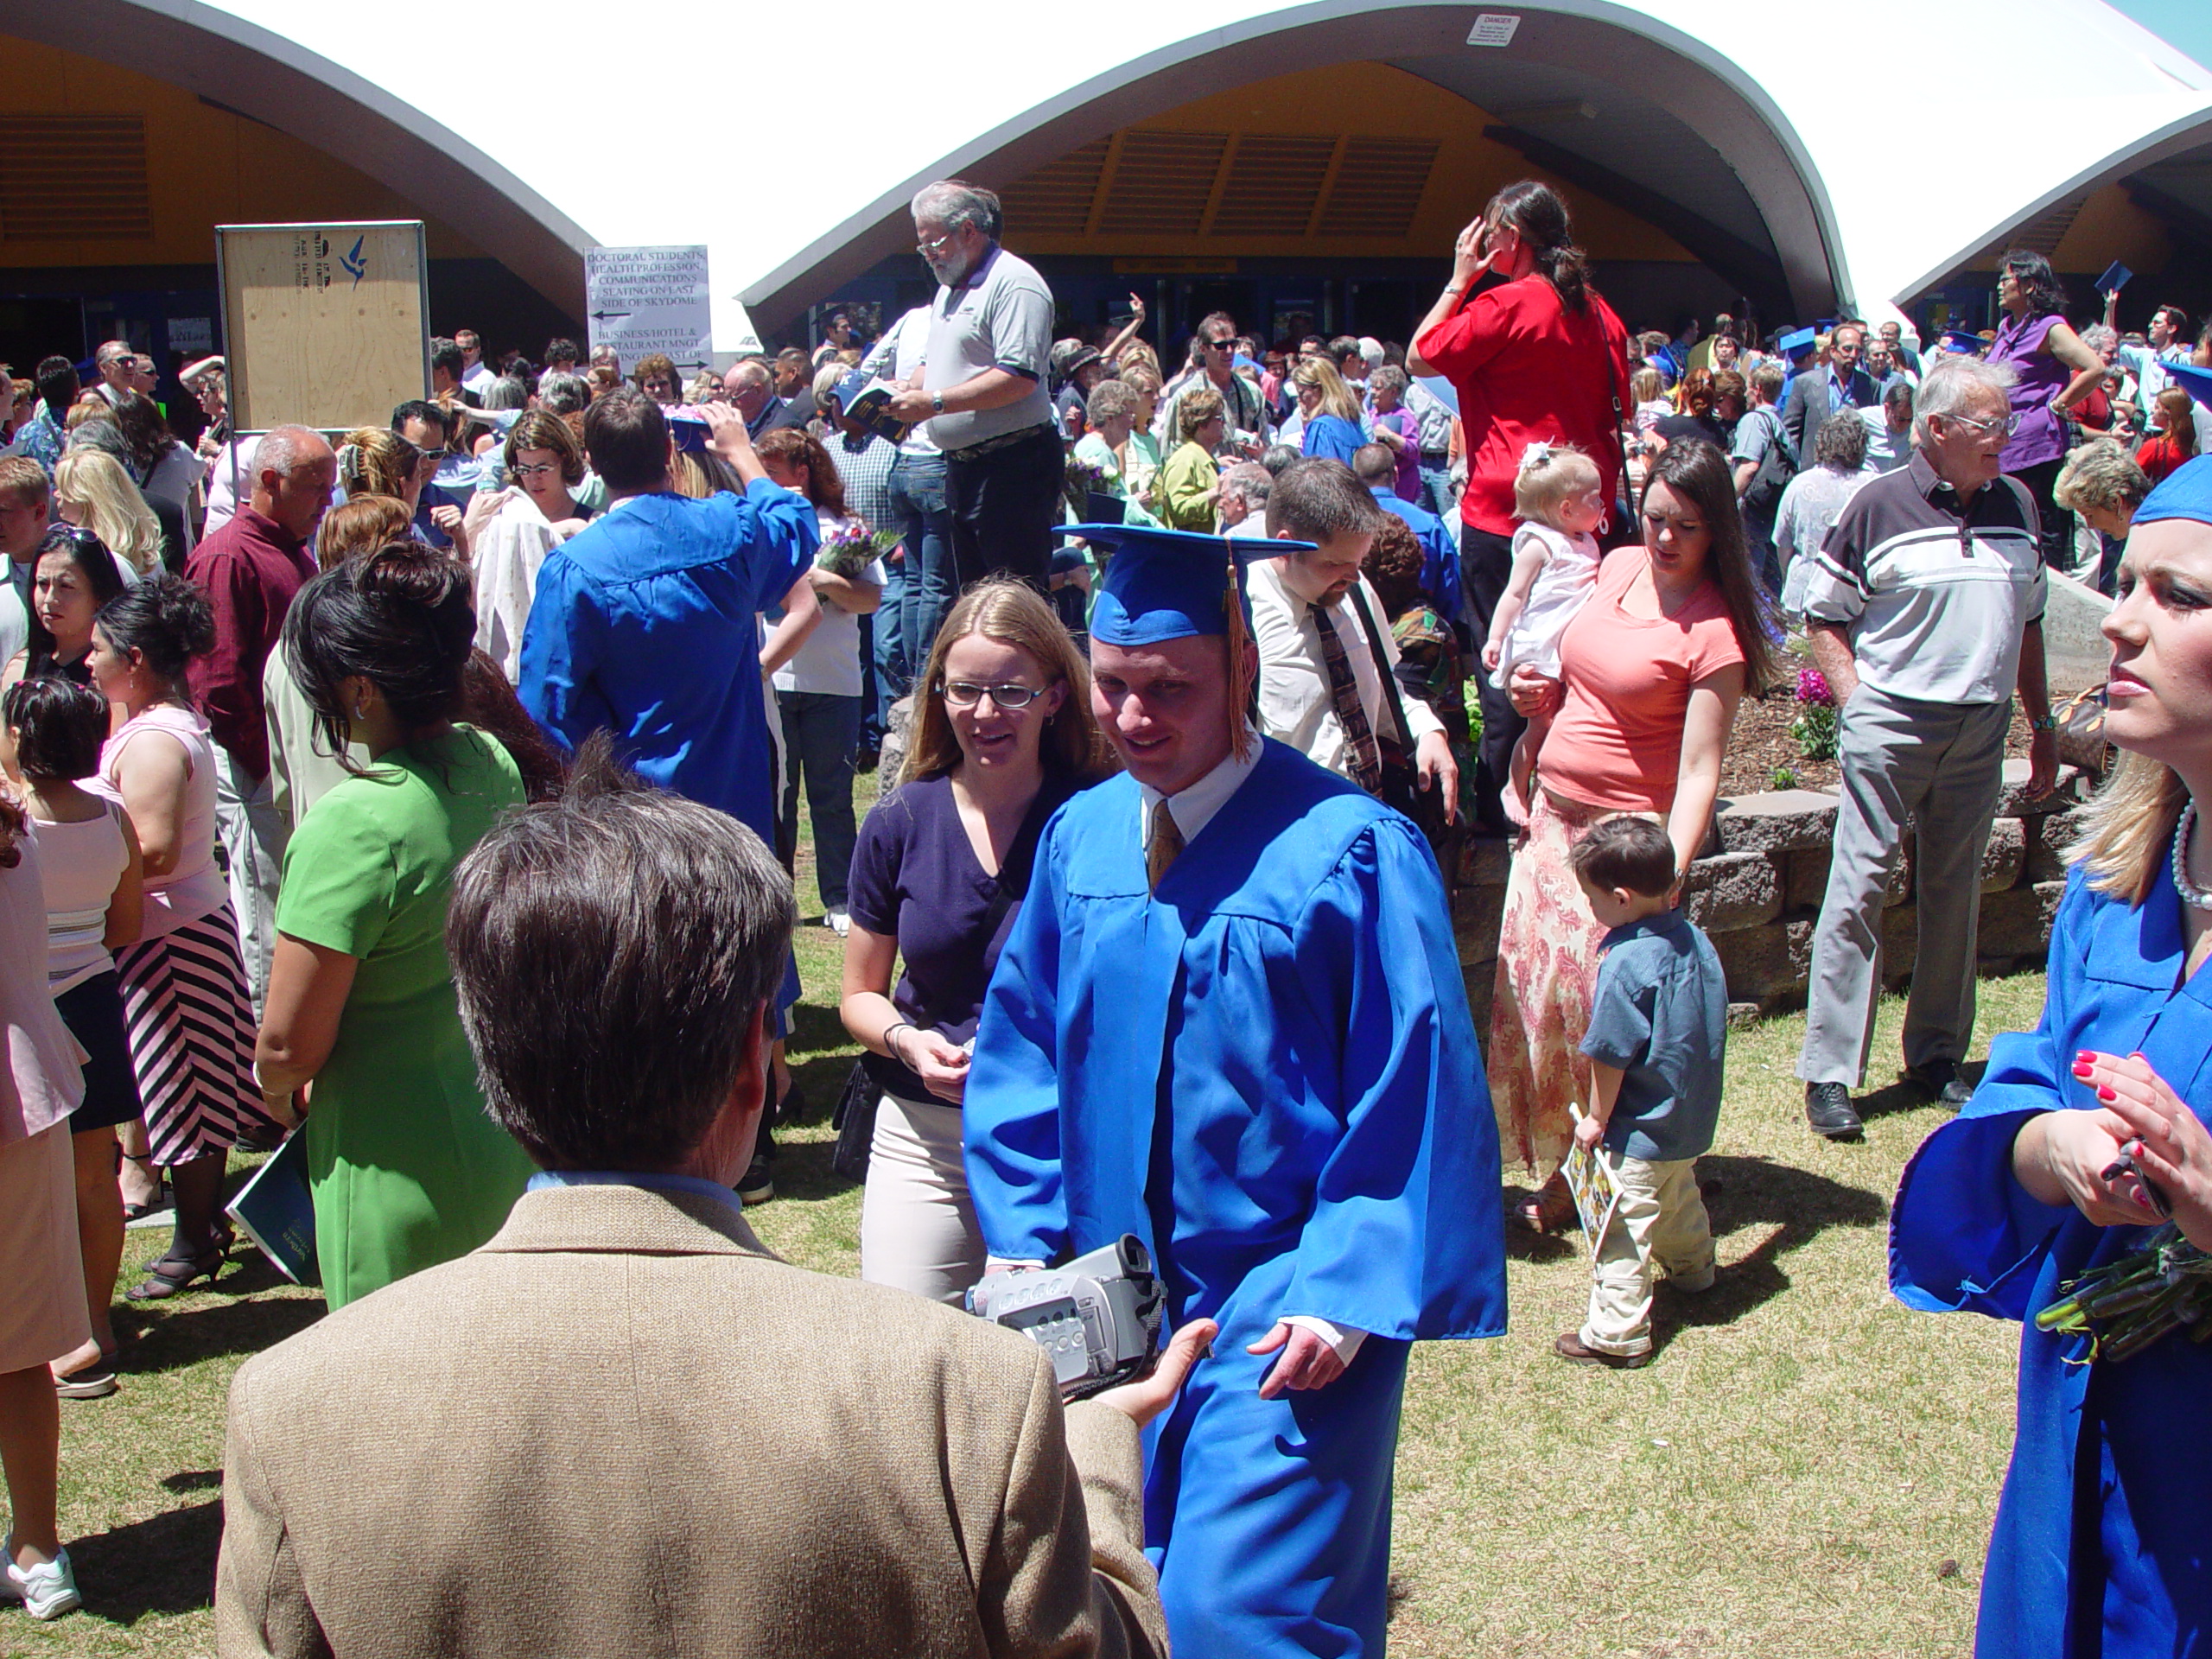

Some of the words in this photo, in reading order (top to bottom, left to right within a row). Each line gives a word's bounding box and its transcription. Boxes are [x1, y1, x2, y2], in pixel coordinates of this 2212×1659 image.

[588, 252, 646, 263] DOCTORAL
[592, 264, 634, 274] HEALTH
[599, 274, 697, 285] COMMUNICATIONS
[603, 286, 648, 297] SEATING
[650, 286, 666, 296] ON
[669, 285, 694, 295] EAST
[601, 299, 627, 308] SIDE
[628, 298, 641, 308] OF
[645, 296, 697, 307] SKYDOME
[598, 328, 687, 340] BUSINESS/HOTEL
[689, 327, 697, 336] &
[597, 340, 666, 350] STAURANT
[669, 339, 699, 348] MNGT
[689, 349, 702, 359] OF
